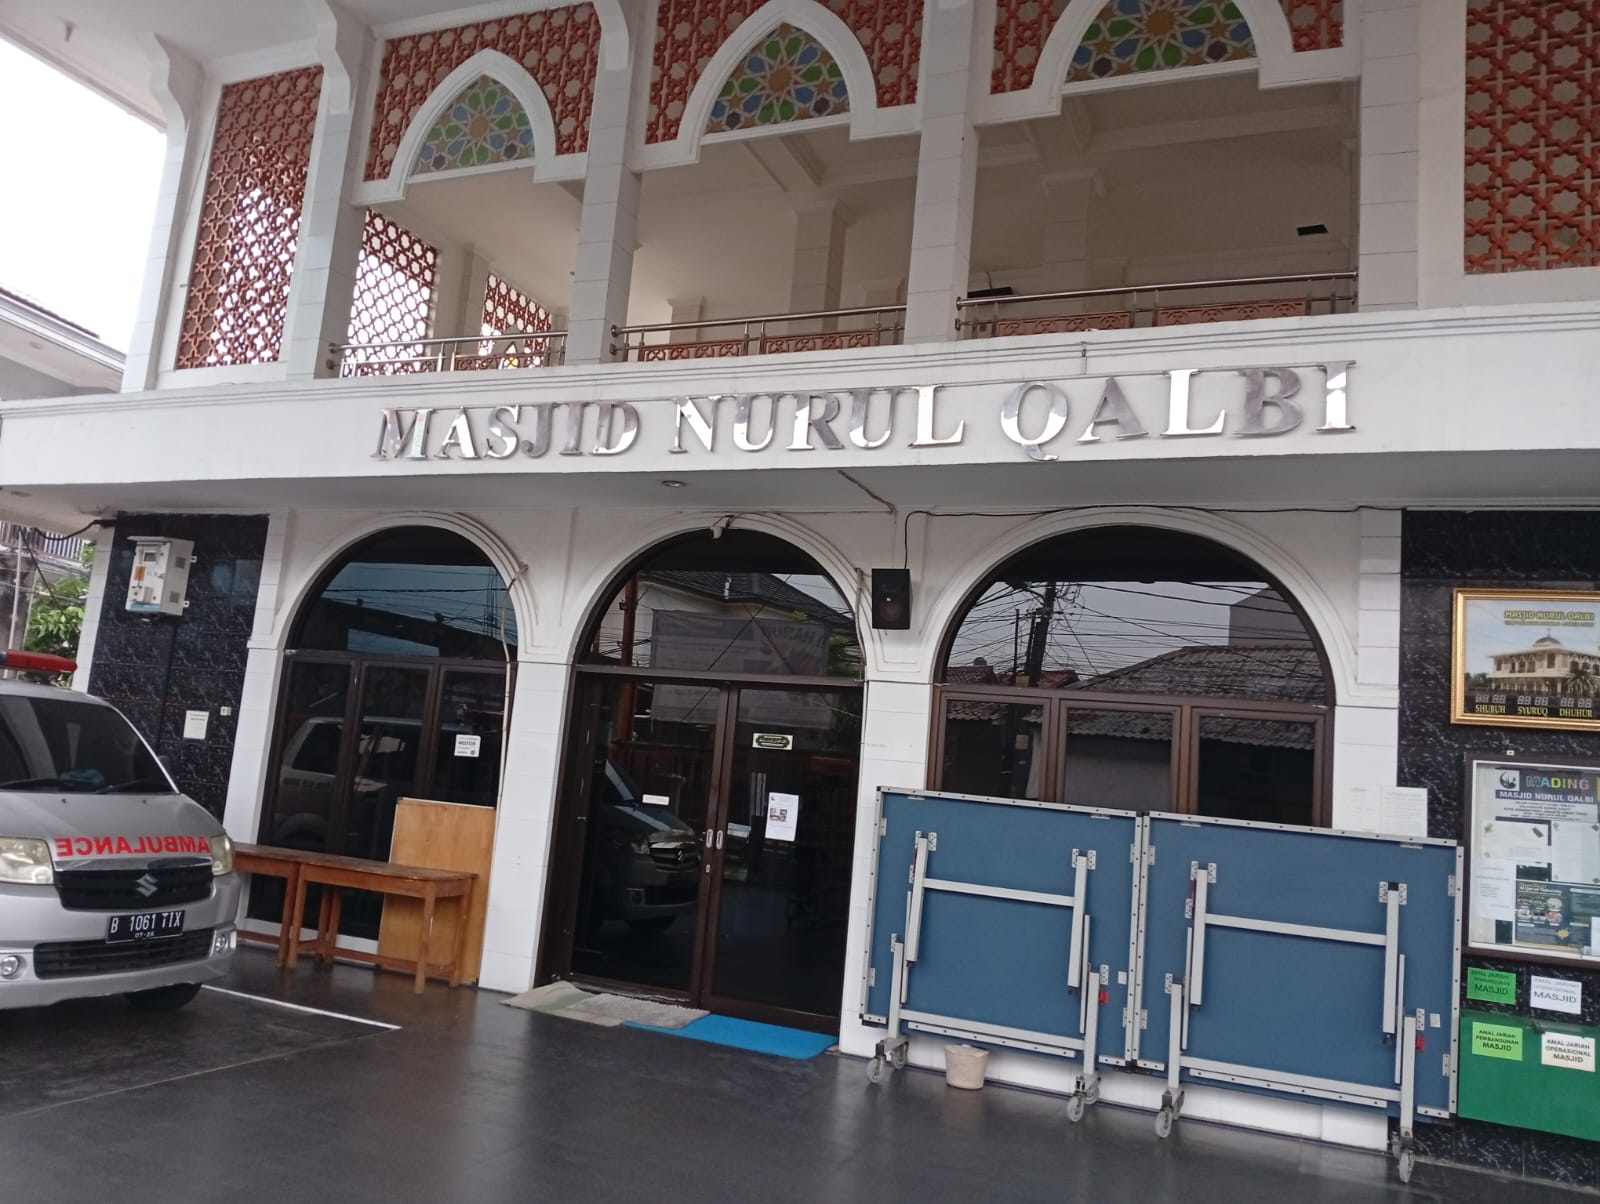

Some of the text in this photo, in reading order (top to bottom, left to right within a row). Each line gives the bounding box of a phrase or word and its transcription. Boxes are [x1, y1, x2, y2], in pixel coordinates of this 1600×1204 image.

[370, 359, 1357, 462] MASJID NURUL QALBI
[1475, 704, 1506, 713] SHUBUH
[1517, 706, 1549, 717] SYURUQ
[1559, 708, 1593, 718] DHUHUR
[1526, 775, 1590, 791] MADING
[1499, 791, 1594, 803] MASJID NURUL QALBI
[110, 911, 182, 934] B 1061 TIX
[1474, 984, 1509, 995] MASJID
[1533, 991, 1576, 1003] MASJID
[1482, 1041, 1512, 1051] MASJID
[1544, 1045, 1592, 1057] OPERASIONAL
[1553, 1053, 1584, 1063] MASJID
